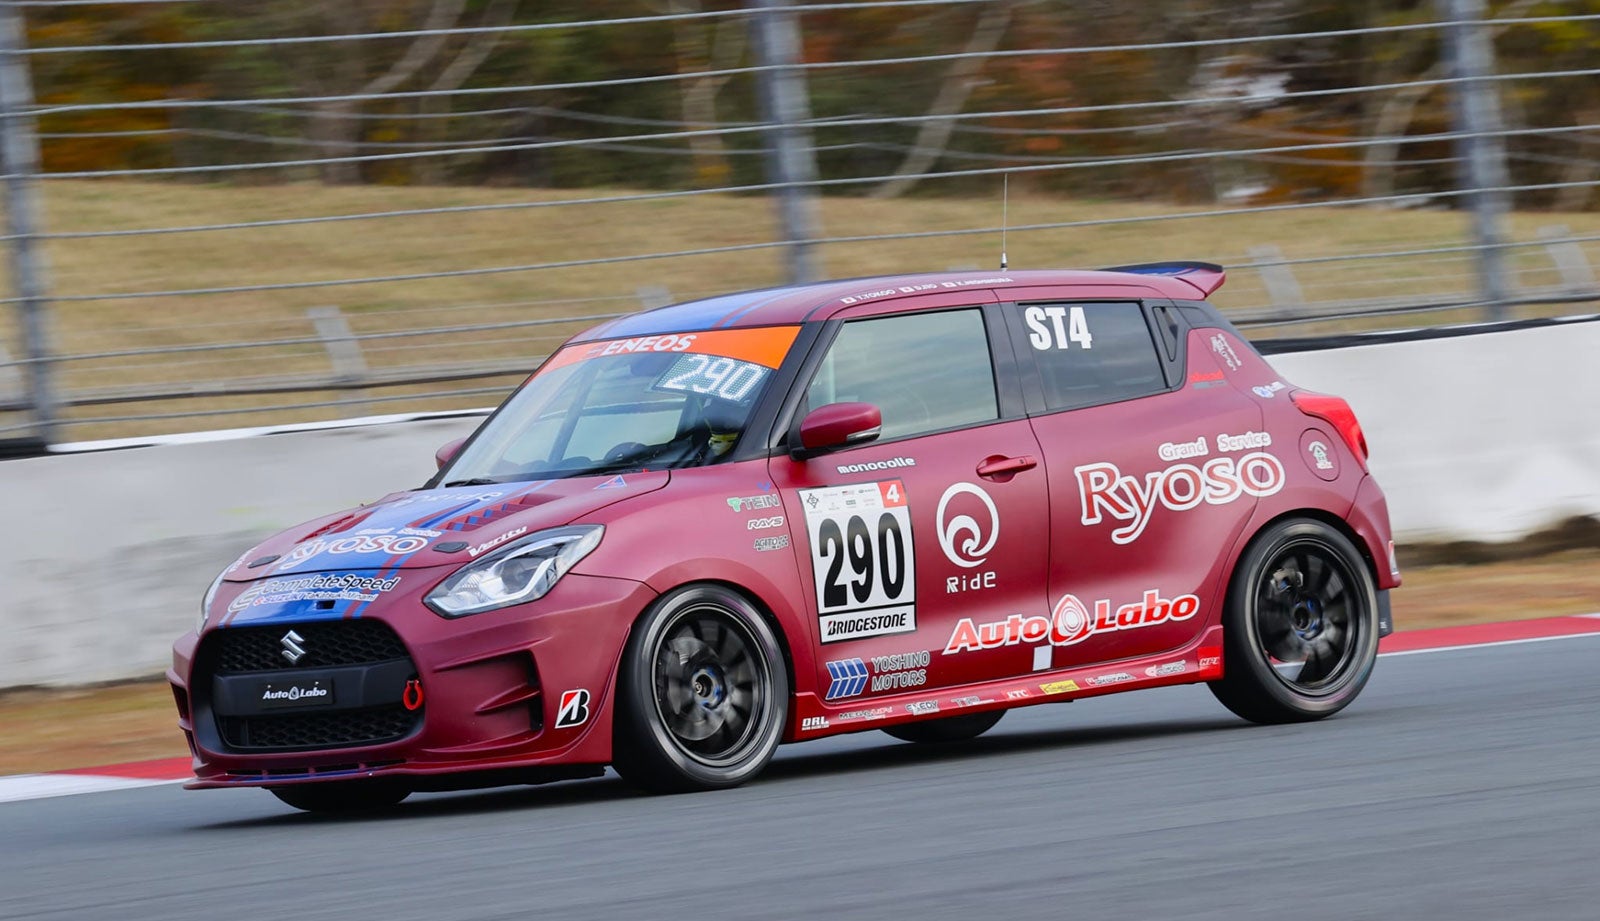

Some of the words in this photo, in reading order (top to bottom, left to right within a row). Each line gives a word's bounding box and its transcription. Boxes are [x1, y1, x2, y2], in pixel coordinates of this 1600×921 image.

[1024, 306, 1092, 350] ST4
[603, 334, 697, 354] ENEOS
[662, 354, 763, 400] 290
[1158, 437, 1209, 460] Grand
[1217, 431, 1271, 452] Service
[836, 457, 916, 474] monocolle
[741, 494, 780, 510] TEIN
[886, 484, 900, 503] 4
[1074, 452, 1285, 545] Ryoso
[469, 526, 528, 557] Verity
[818, 512, 905, 608] 290
[946, 571, 996, 593] Ride
[827, 613, 907, 636] BRIDGESTONE
[942, 614, 1049, 655] Auto
[1095, 589, 1199, 634] Labo
[870, 651, 931, 673] YOSHINO
[871, 669, 927, 692] MOTORS
[262, 686, 289, 700] Auto
[300, 685, 327, 699] Labo
